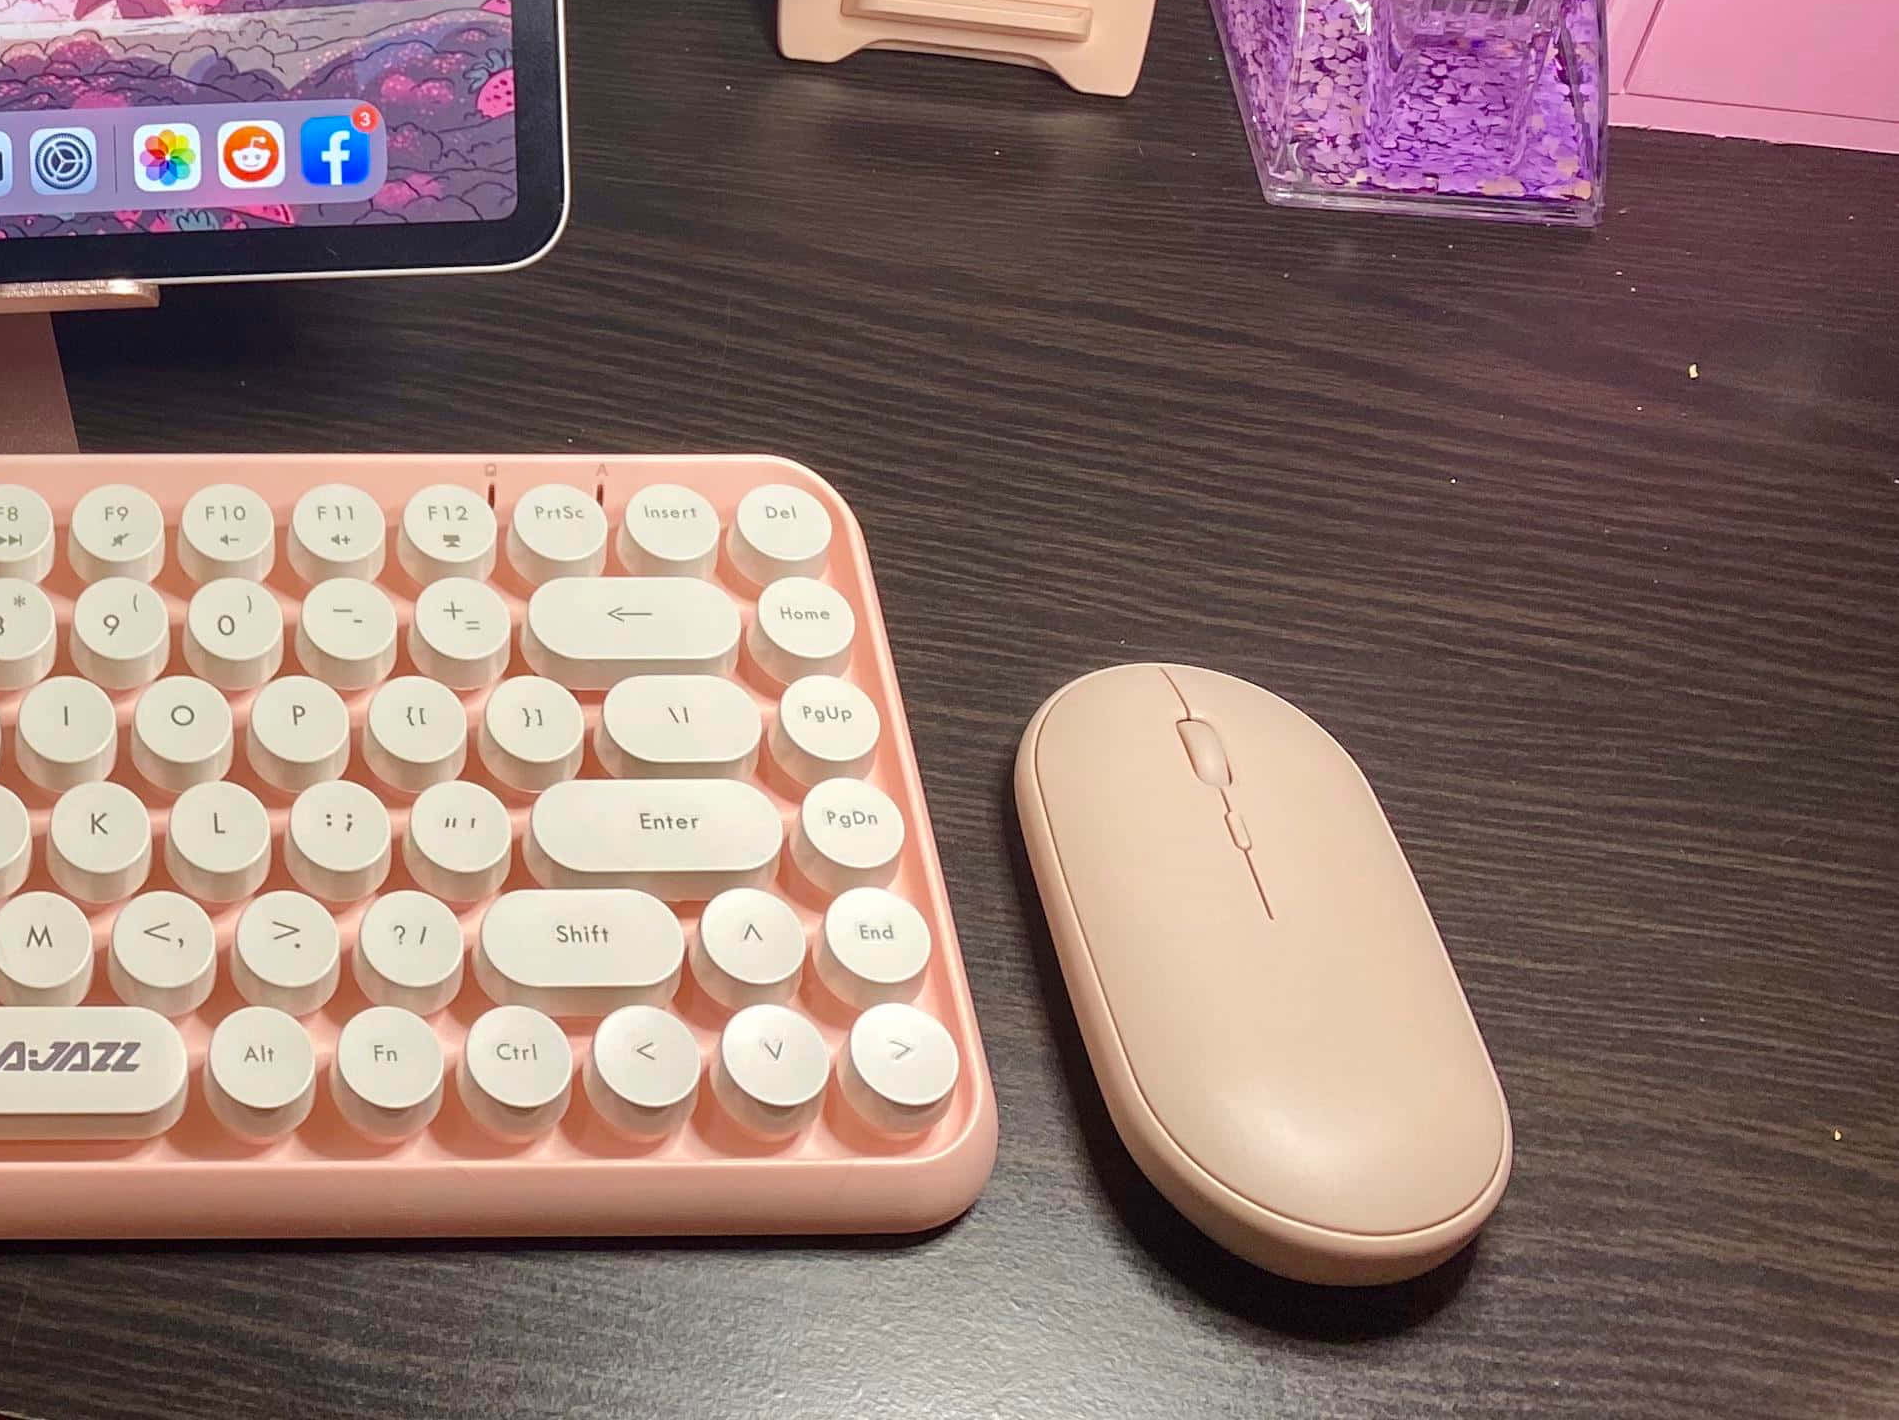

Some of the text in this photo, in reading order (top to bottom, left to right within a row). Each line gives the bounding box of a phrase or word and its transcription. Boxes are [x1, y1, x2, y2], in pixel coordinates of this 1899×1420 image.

[360, 112, 370, 126] 3
[104, 506, 129, 522] F9
[205, 505, 247, 522] F10
[317, 505, 354, 521] F11
[427, 505, 469, 522] F12
[533, 505, 585, 520] PrtSc
[643, 504, 697, 519] Insert
[765, 505, 798, 520] Del
[779, 606, 831, 621] Home
[292, 704, 306, 726] P
[802, 705, 853, 724] PgUp
[90, 812, 109, 835] K
[213, 811, 226, 835] L
[639, 812, 699, 831] Enter
[826, 809, 879, 829] PgDn
[556, 924, 609, 944] Shift
[858, 923, 895, 940] End
[243, 1044, 275, 1063] Alt
[373, 1044, 398, 1062] Fn
[496, 1043, 538, 1061] Ctrl
